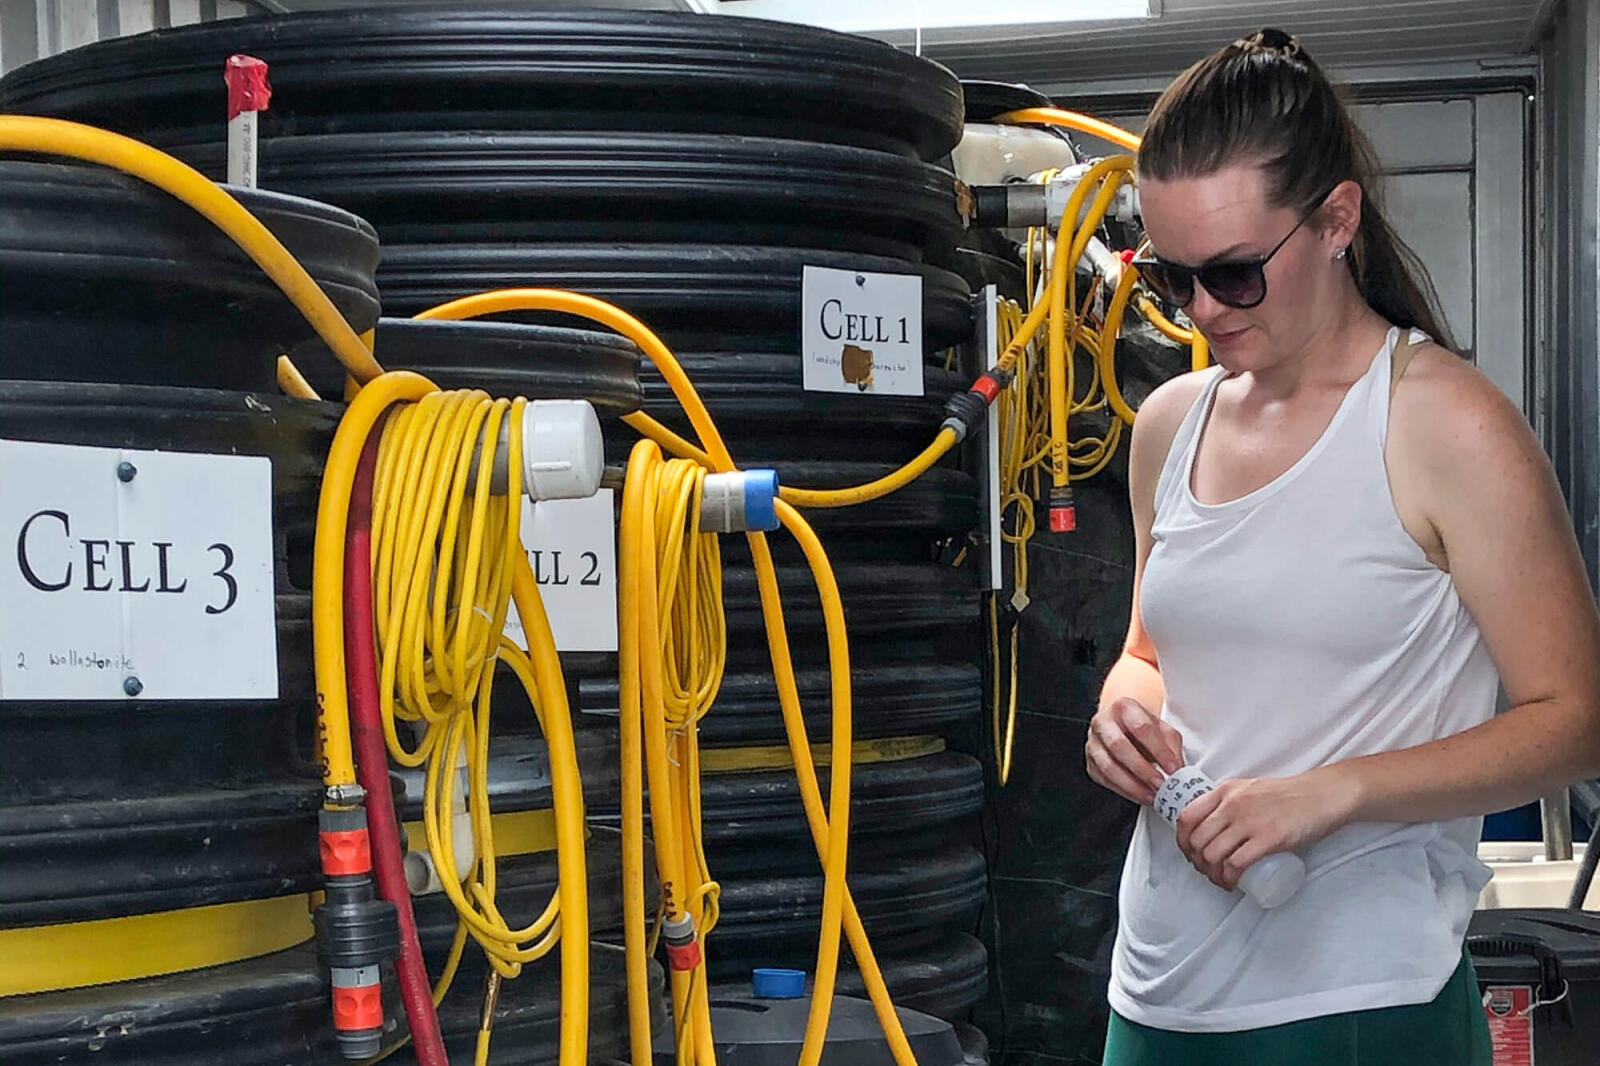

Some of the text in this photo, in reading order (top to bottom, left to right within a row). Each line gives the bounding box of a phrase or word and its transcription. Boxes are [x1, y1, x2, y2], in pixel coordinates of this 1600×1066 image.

[820, 299, 910, 344] CELL 1
[17, 510, 239, 614] CELL 3
[526, 550, 601, 586] LL 2
